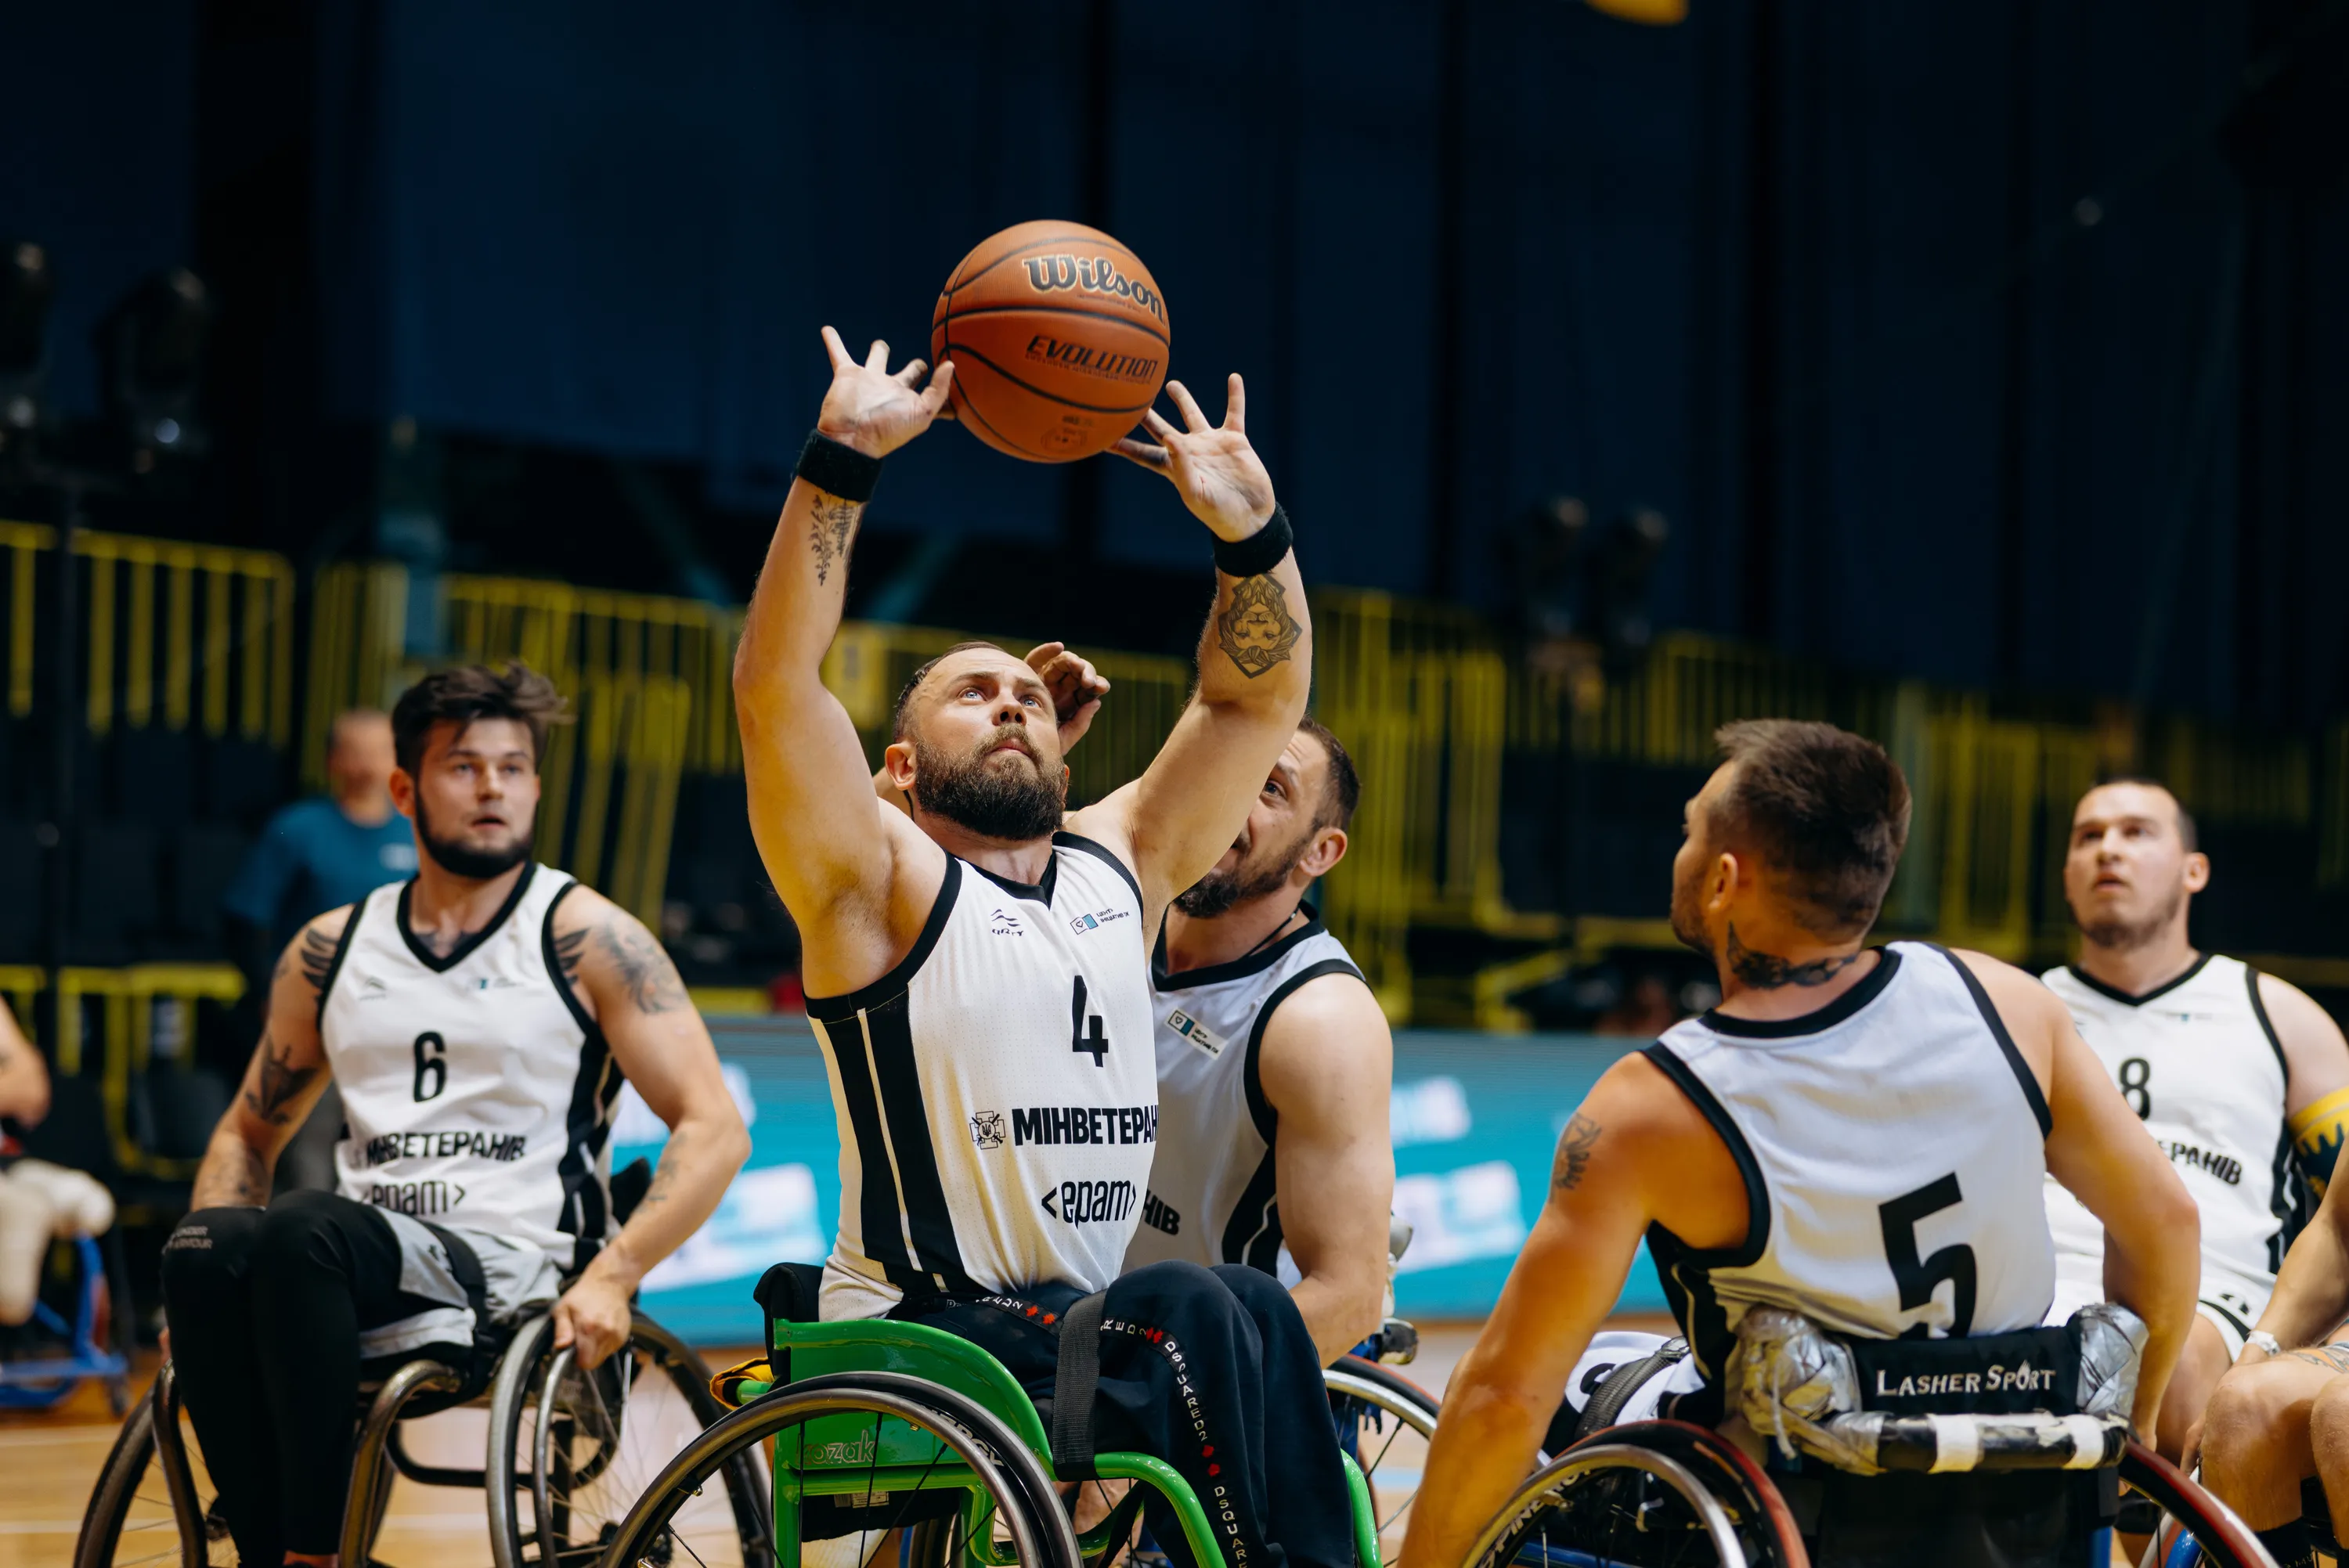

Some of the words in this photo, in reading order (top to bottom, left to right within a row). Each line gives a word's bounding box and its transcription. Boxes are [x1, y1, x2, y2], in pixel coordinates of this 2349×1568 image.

[1023, 254, 1166, 327] Wilson
[1027, 335, 1158, 381] EVOLUTION
[1072, 975, 1109, 1067] 4
[413, 1032, 446, 1102] 6
[2119, 1058, 2150, 1120] 8
[1878, 1172, 1976, 1340] 5
[1876, 1369, 1982, 1397] LASHER
